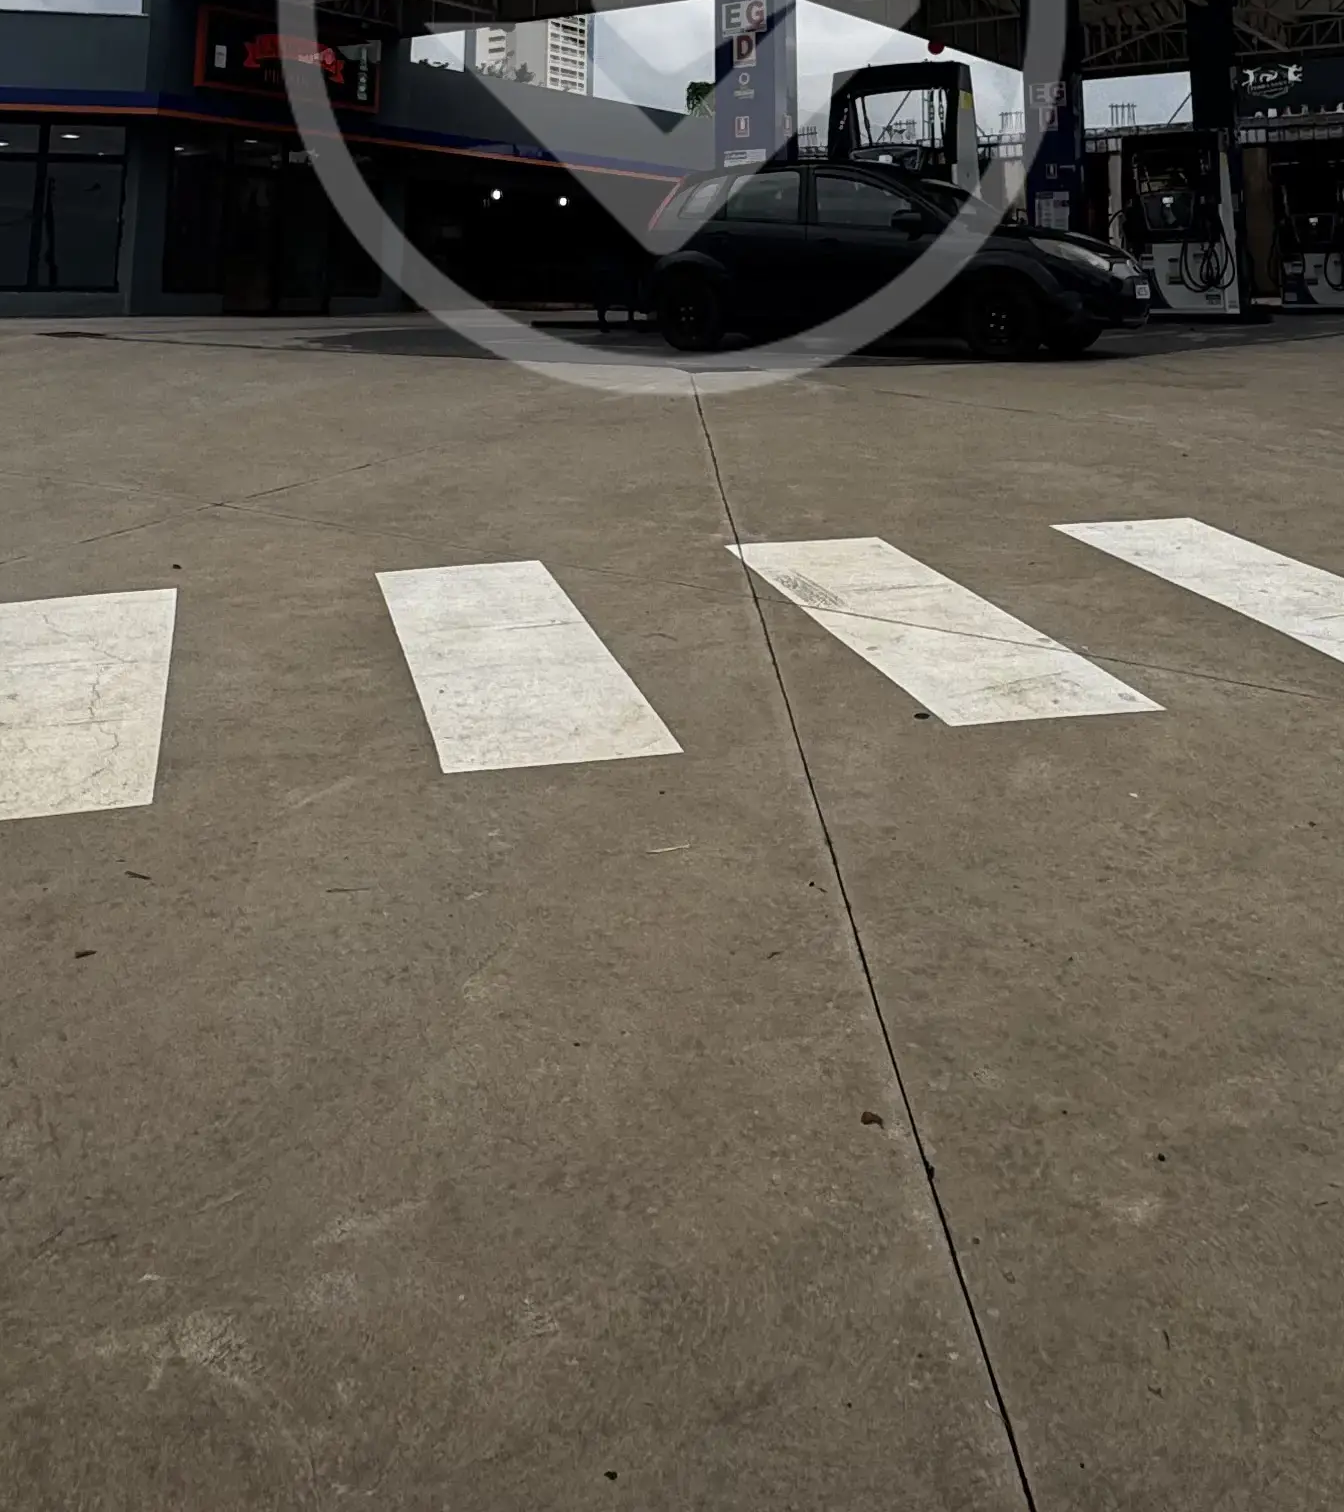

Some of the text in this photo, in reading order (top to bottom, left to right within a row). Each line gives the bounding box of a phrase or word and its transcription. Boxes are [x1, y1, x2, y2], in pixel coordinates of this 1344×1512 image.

[725, 0, 764, 29] E G
[736, 35, 754, 60] D
